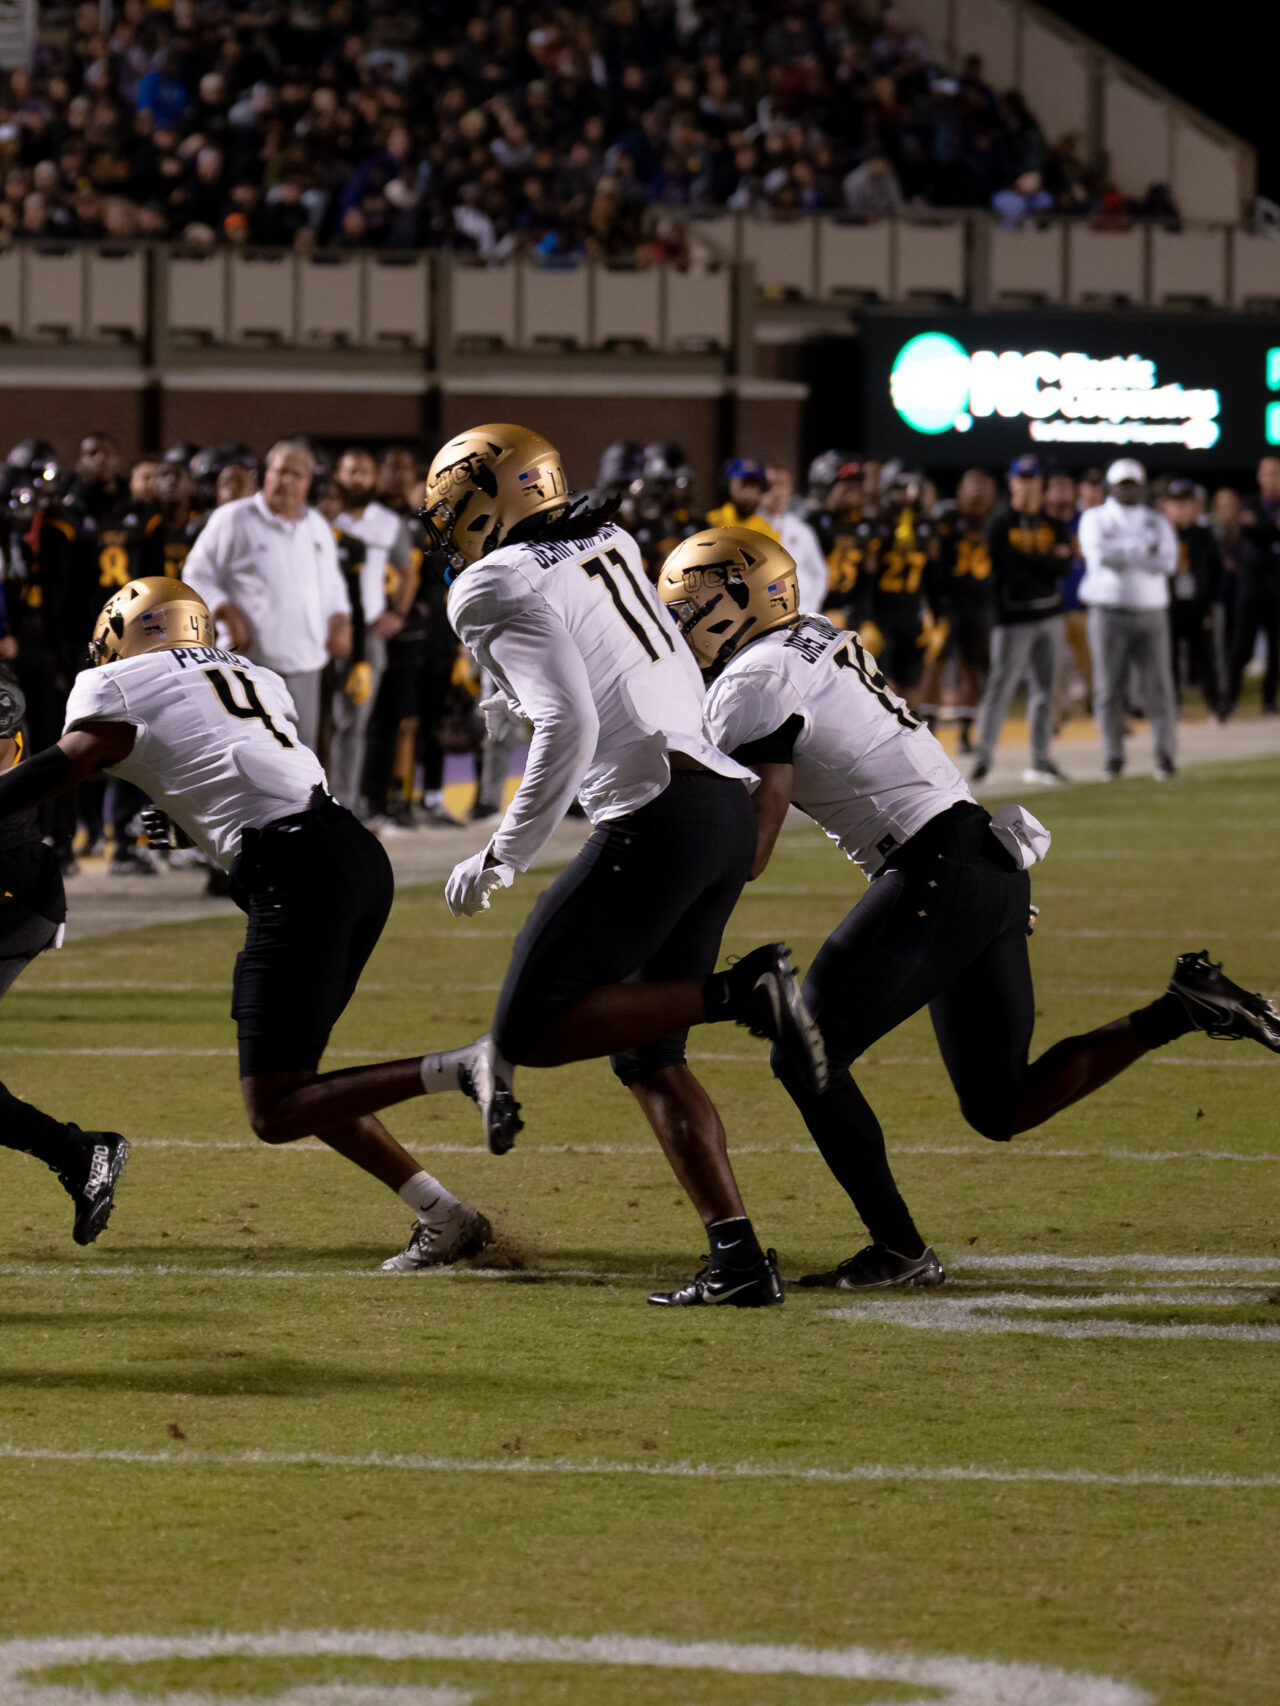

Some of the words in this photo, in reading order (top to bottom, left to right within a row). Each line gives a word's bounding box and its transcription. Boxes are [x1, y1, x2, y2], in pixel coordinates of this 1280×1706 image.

[189, 615, 200, 640] 4
[578, 544, 677, 665] 11
[201, 666, 297, 751] 4
